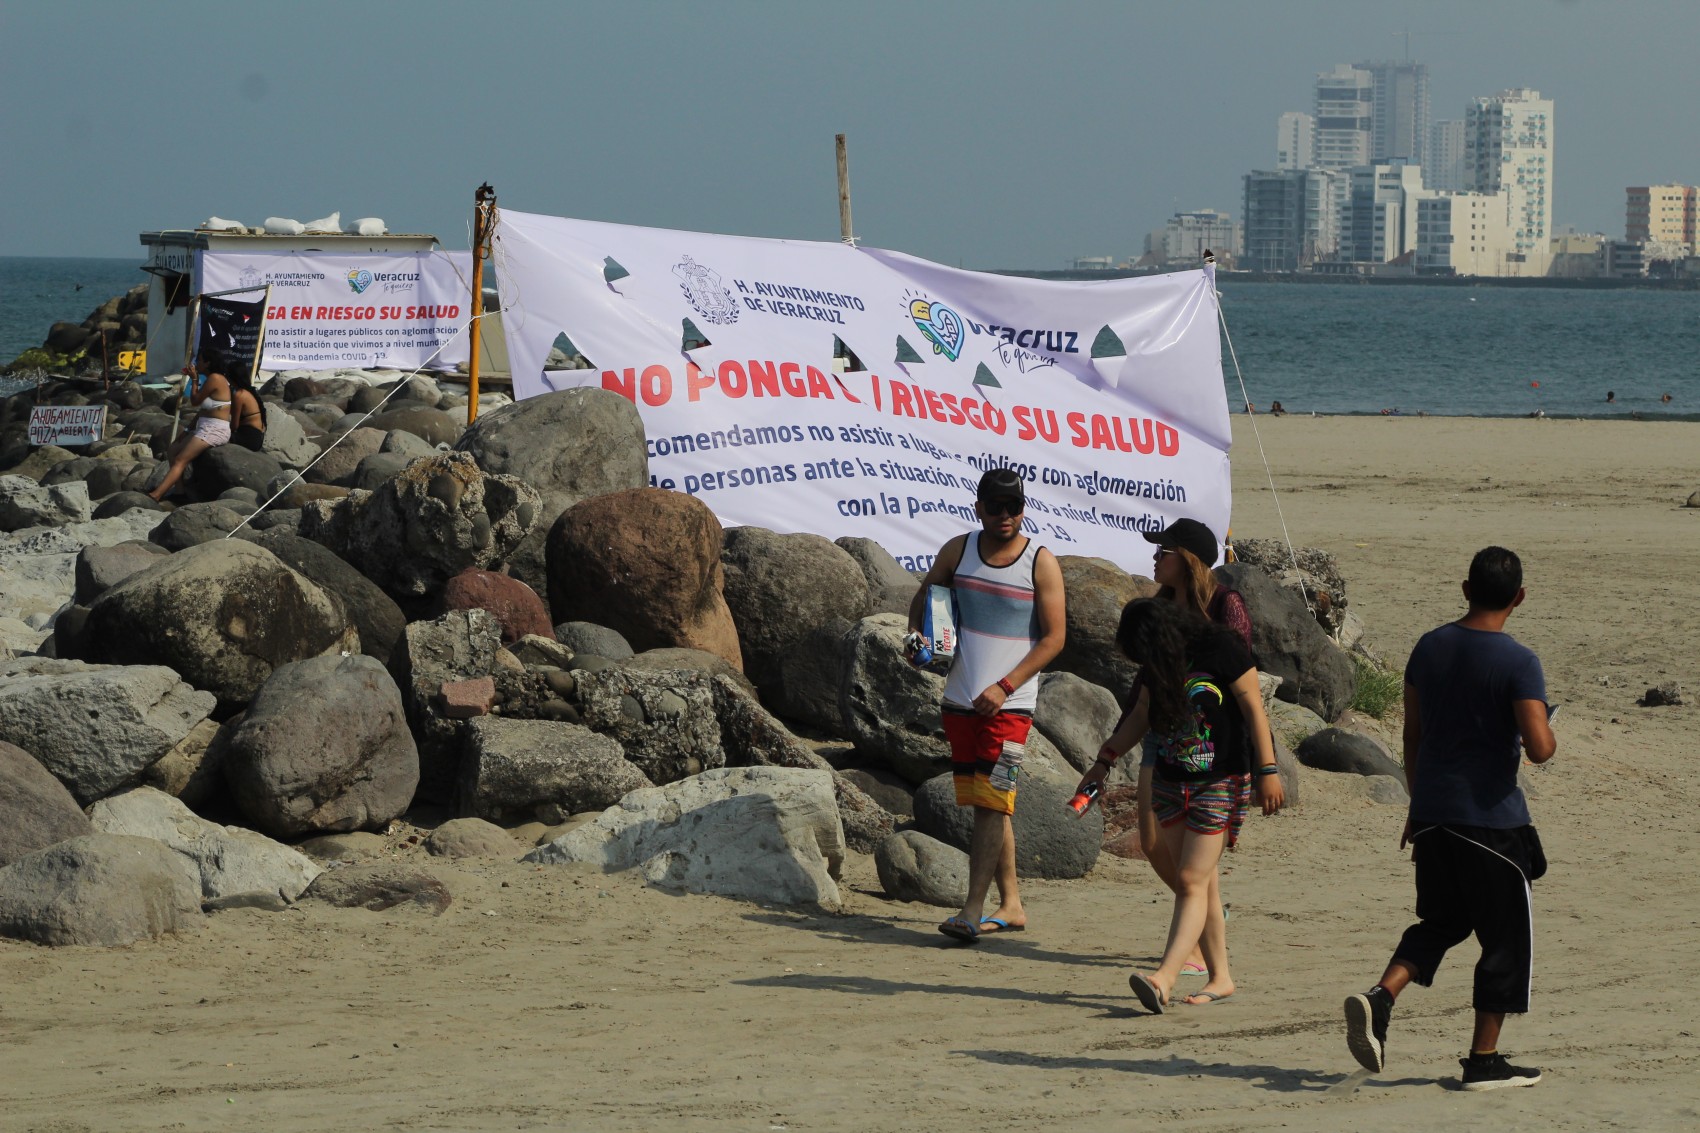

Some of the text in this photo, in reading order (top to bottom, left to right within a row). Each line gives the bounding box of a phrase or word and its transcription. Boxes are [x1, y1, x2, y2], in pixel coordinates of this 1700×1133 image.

[155, 254, 195, 269] GUARDAVID
[374, 272, 420, 282] Veracruz
[733, 279, 865, 312] H. AYUNTAMIENTO
[266, 304, 460, 320] GA EN RIESGO SU SALUD
[743, 297, 846, 325] DE VERACRUZ
[268, 328, 279, 336] no
[280, 327, 307, 336] asistir
[308, 328, 314, 336] a
[315, 326, 347, 337] lugares
[348, 326, 383, 337] públicos
[385, 327, 400, 336] con
[401, 325, 458, 337] aglomeración
[283, 340, 291, 348] la
[292, 340, 331, 349] situación
[333, 341, 349, 349] que
[351, 340, 384, 348] vivimos
[393, 339, 414, 348] nivel
[288, 352, 297, 361] la
[298, 352, 340, 362] pandemia
[341, 352, 367, 360] COVID
[602, 364, 673, 407] NO
[686, 359, 836, 402] PONGA
[30, 407, 102, 425] AHOGAMIENTO
[889, 379, 1007, 436] RIESGO
[1011, 405, 1060, 444] SU
[1066, 411, 1180, 457] SALUD
[31, 425, 96, 443] POZA ABIERTA
[646, 424, 805, 458] comendamos
[808, 424, 835, 442] no
[839, 424, 894, 447] asistir
[897, 434, 911, 449] a
[1042, 467, 1071, 487] con
[1073, 470, 1187, 503] aglomeración
[684, 463, 798, 496] personas
[804, 458, 855, 482] ante
[860, 457, 877, 478] la
[880, 462, 960, 489] situación
[1050, 503, 1060, 517] a
[1059, 503, 1101, 526] nivel
[1100, 511, 1166, 533] mundial
[837, 499, 876, 517] con
[880, 492, 901, 515] la
[906, 496, 981, 524] pandemi
[1047, 522, 1078, 543] 19.
[942, 626, 952, 653] TECATE
